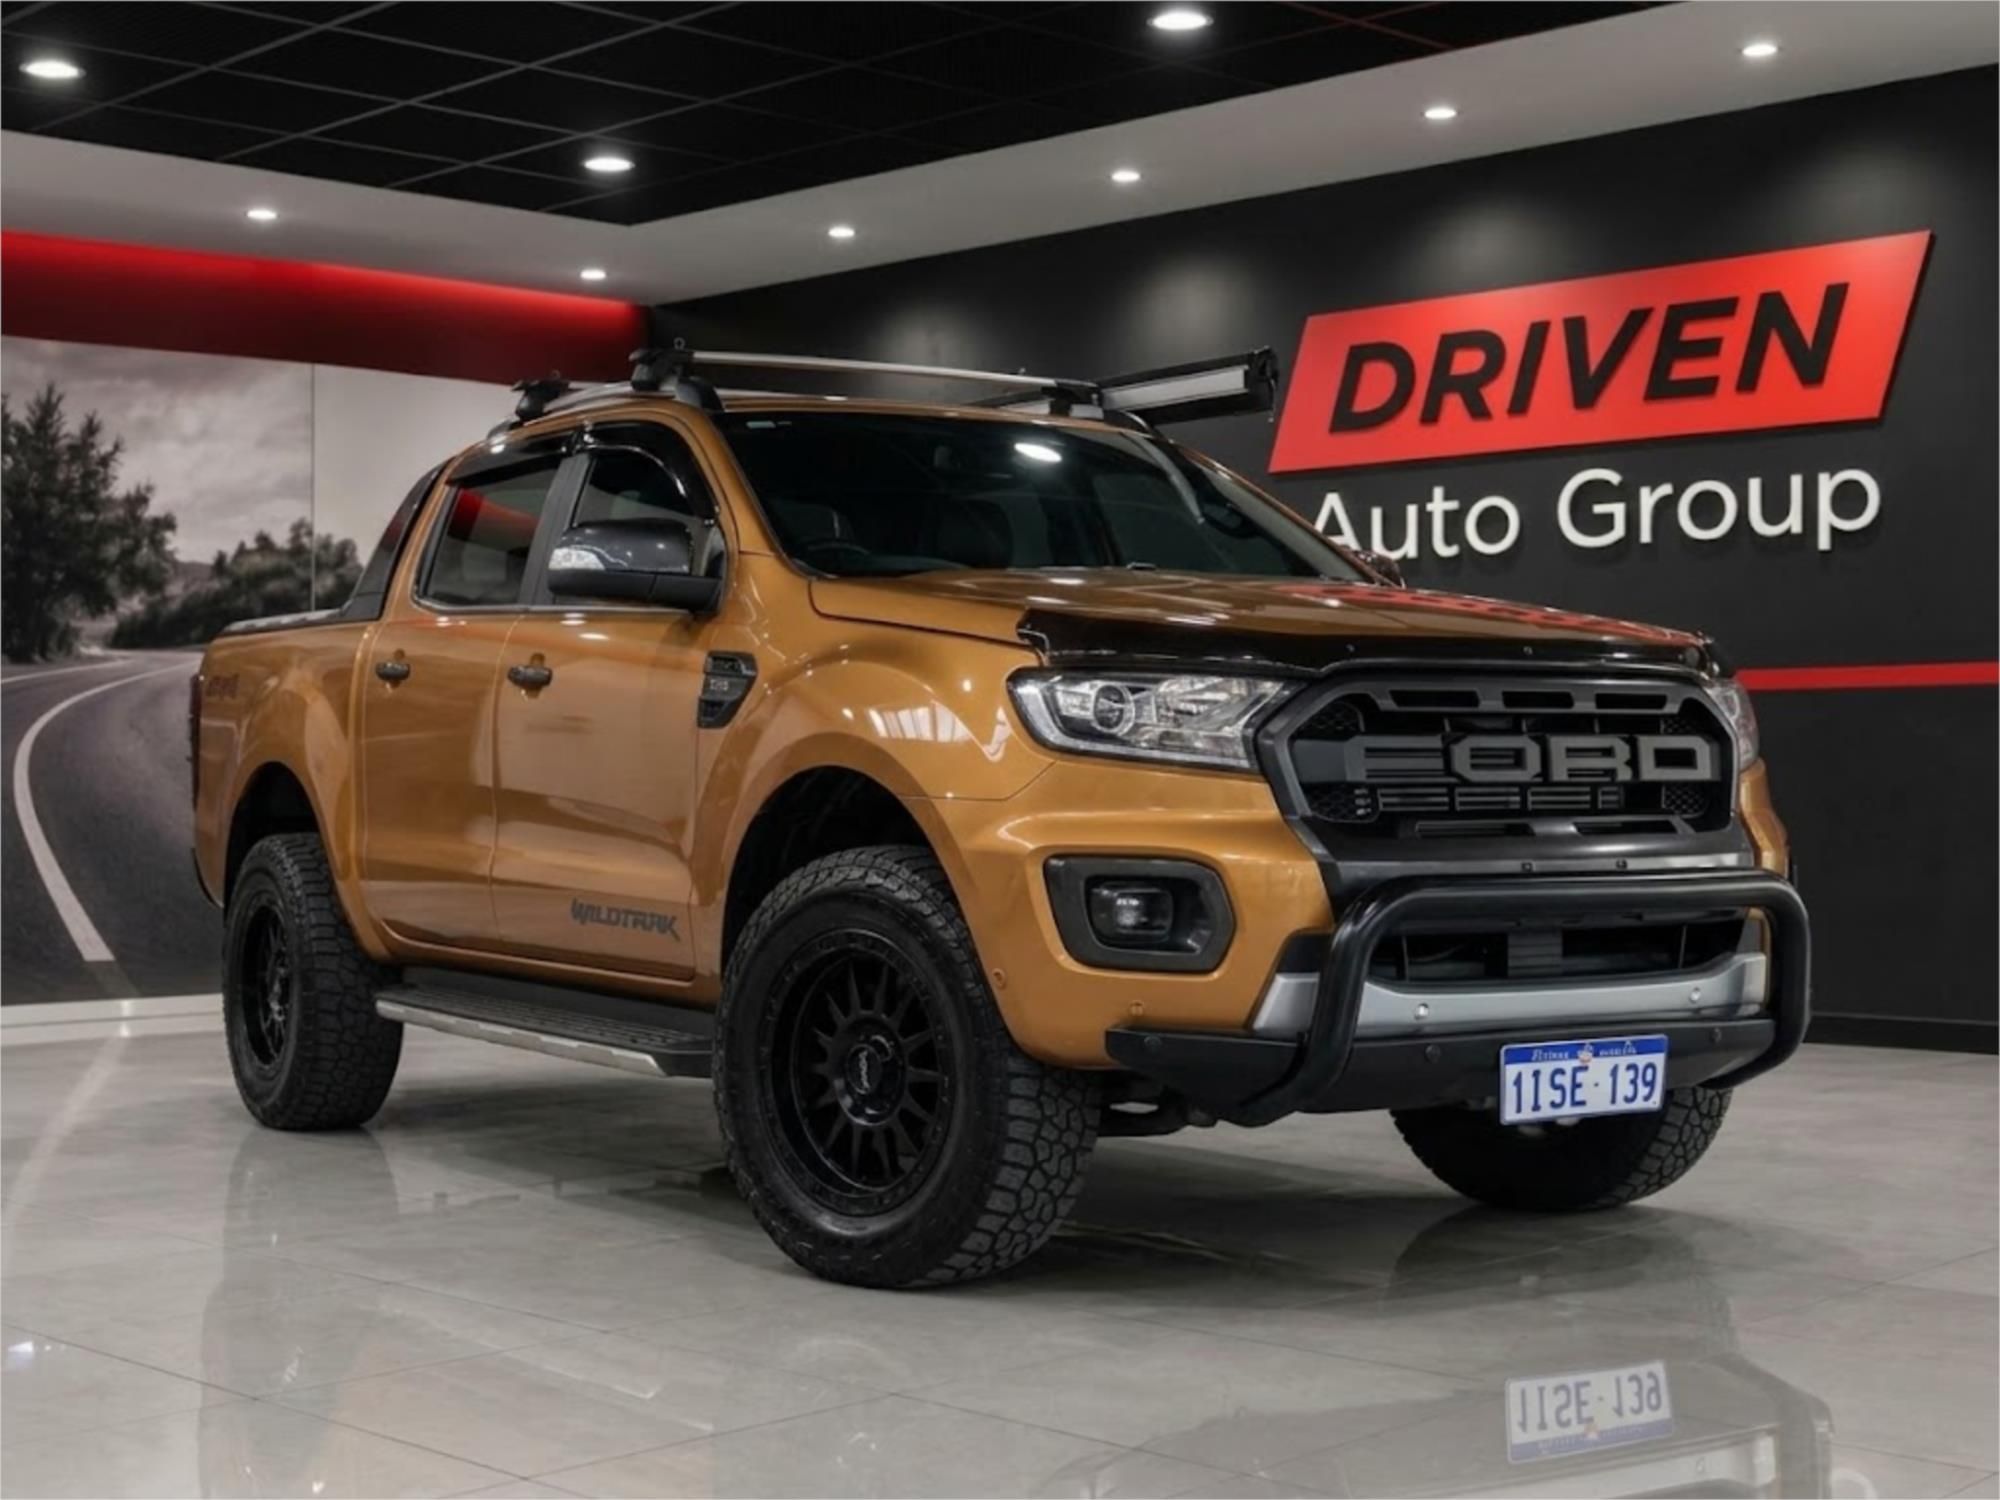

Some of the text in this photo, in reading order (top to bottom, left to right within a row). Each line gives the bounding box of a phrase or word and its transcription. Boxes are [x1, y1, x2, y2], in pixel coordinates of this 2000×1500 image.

[1329, 282, 1850, 434] DRIVEN
[1313, 465, 1881, 560] Auto Group
[1346, 734, 1718, 782] FORD
[570, 896, 681, 942] WILDTRAK
